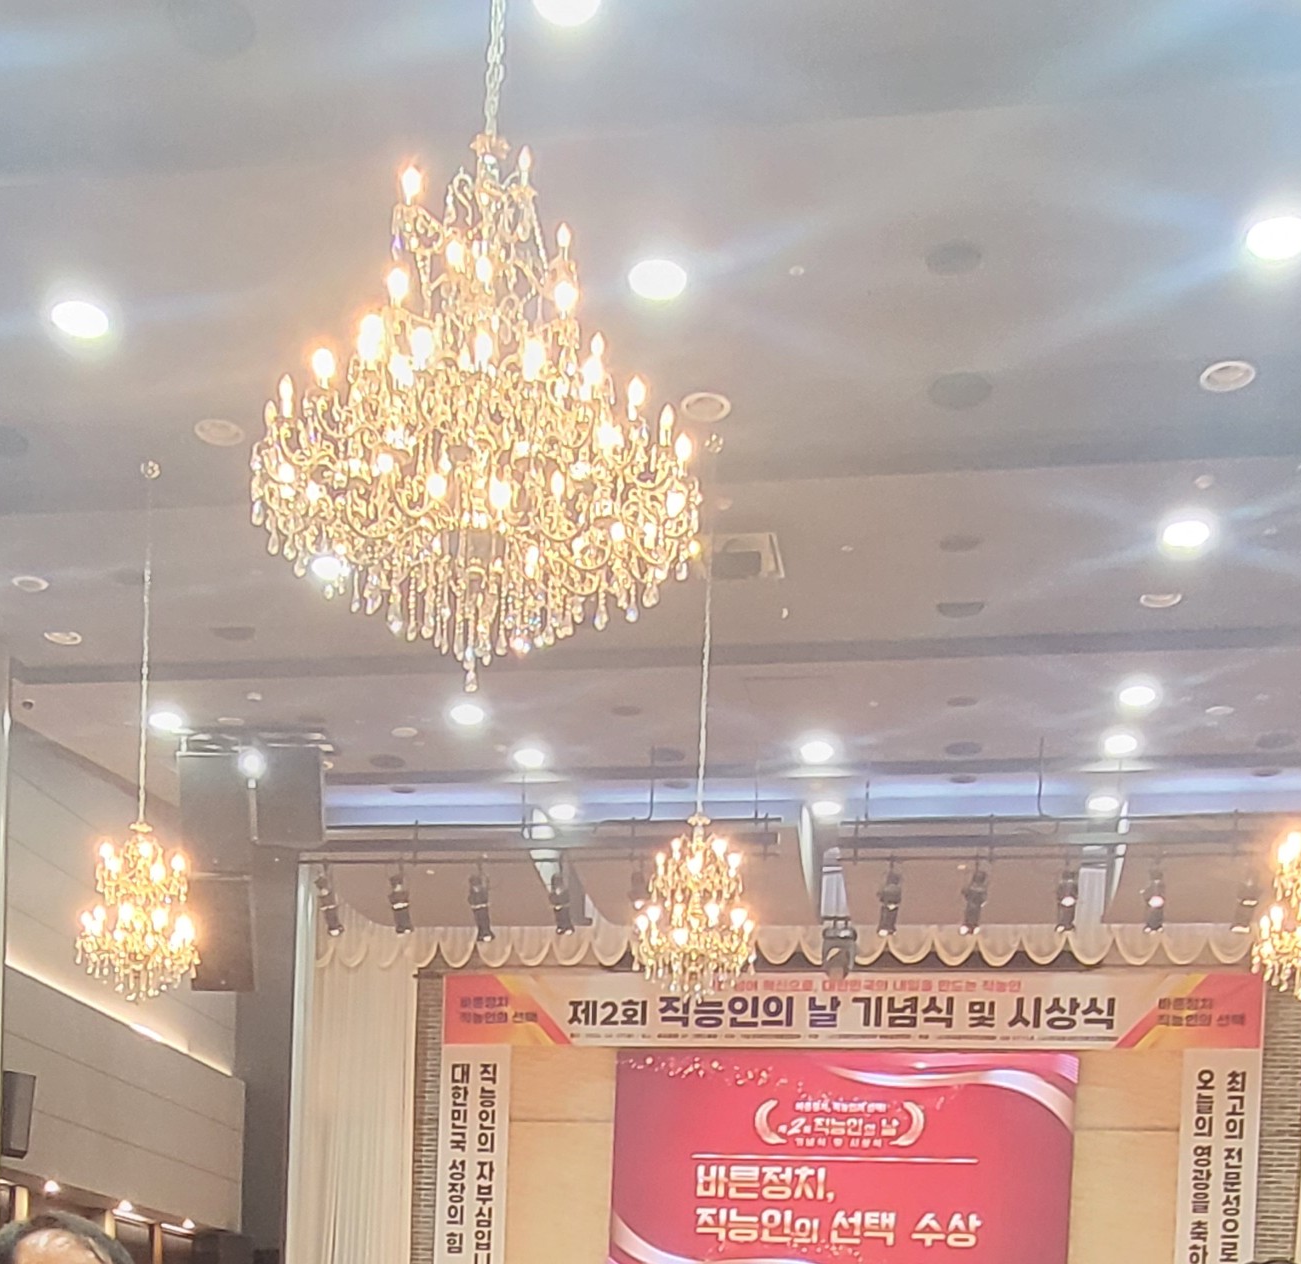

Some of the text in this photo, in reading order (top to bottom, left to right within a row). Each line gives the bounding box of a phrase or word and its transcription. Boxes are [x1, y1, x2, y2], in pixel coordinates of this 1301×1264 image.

[568, 995, 1116, 1031] 제2회 직능인의 날 기념식 및 시상식
[476, 1063, 498, 1153] 직능인의
[1194, 1069, 1215, 1137] 오늘의
[446, 1063, 471, 1254] 대한민국 성장의 힘
[696, 1165, 835, 1202] 바른정치,
[1191, 1145, 1212, 1214] 영광을
[1220, 1070, 1247, 1263] 최고의 전문성으로
[696, 1208, 982, 1247] 직능인의 선택 수상
